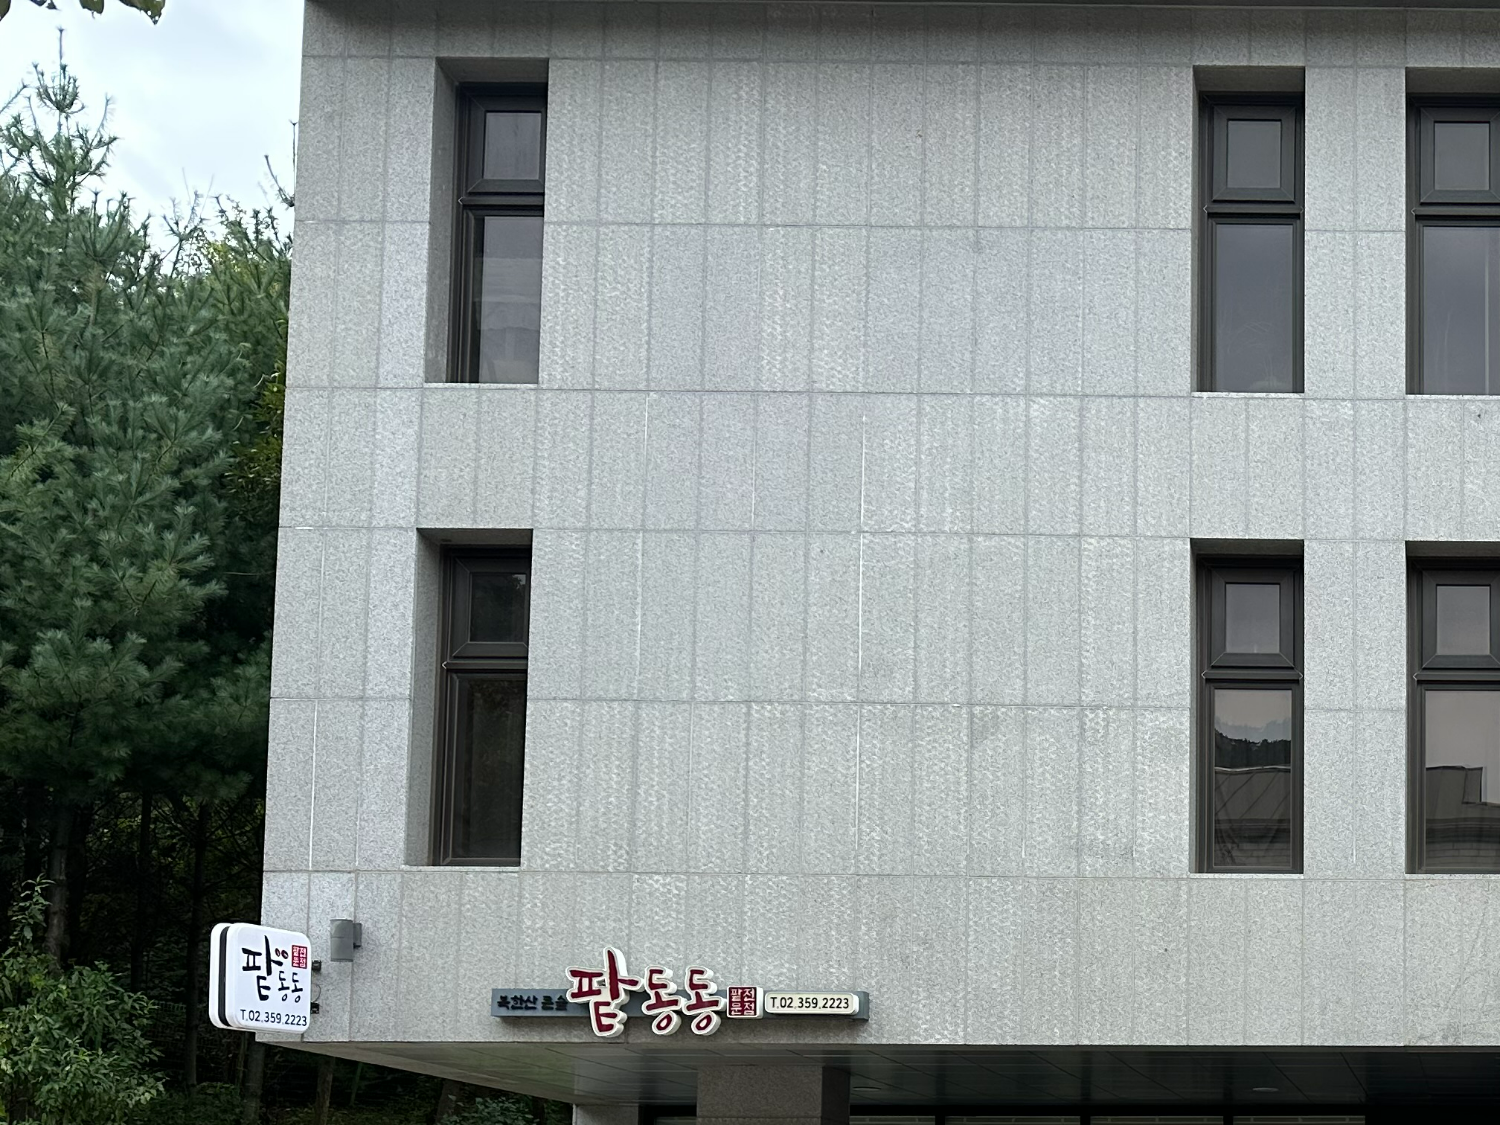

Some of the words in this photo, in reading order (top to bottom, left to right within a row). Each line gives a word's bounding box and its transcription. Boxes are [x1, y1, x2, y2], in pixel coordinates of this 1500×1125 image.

[497, 995, 539, 1010] 북한산
[567, 947, 724, 1036] 팥동동
[770, 996, 850, 1010] T.02.359.2223
[240, 1009, 308, 1027] T.02.359.2223
